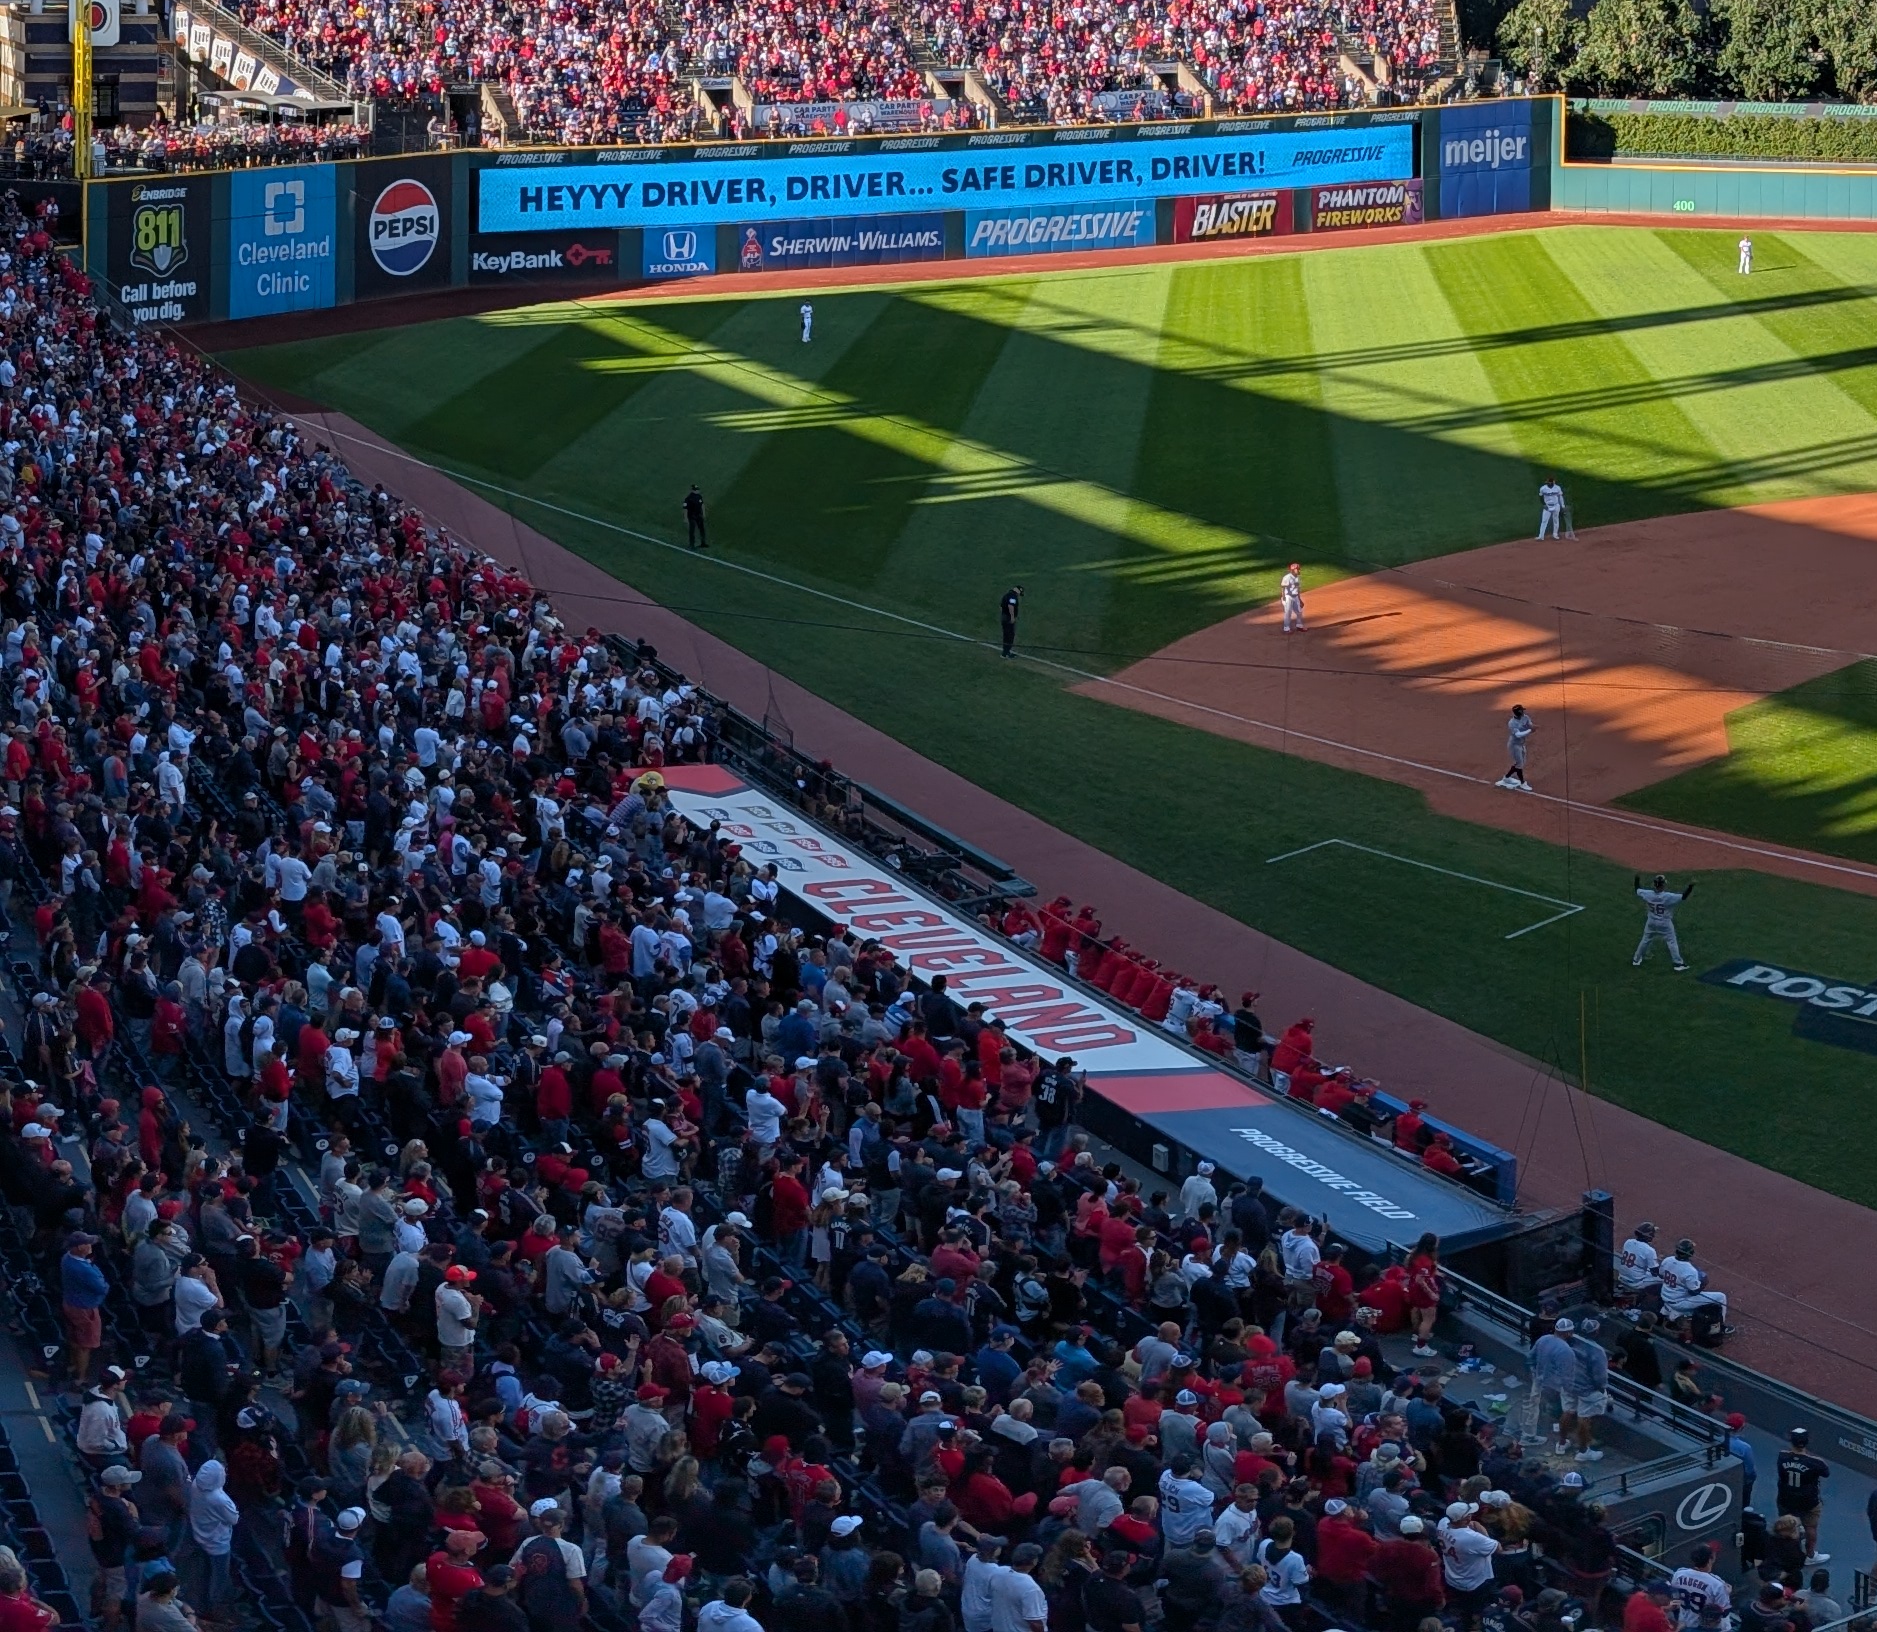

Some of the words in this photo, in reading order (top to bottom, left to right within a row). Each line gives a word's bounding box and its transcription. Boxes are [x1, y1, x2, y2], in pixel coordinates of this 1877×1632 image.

[1217, 120, 1271, 132] PROGRESSIVE
[1294, 116, 1347, 127] PROGRESSIVE
[1370, 111, 1420, 123] PROGRESSIVE
[1054, 129, 1110, 141] PROGRESSIVE
[1137, 125, 1192, 136] PROGRESSIVE
[1445, 129, 1526, 168] meijer
[519, 183, 634, 212] HEYYY
[642, 178, 777, 208] DRIVER,
[786, 171, 934, 201] DRIVER...
[941, 166, 1016, 194] SAFE
[1024, 159, 1143, 188] DRIVER,
[1151, 150, 1265, 180] DRIVER!
[1292, 145, 1385, 166] PROGRESSIVE
[1318, 185, 1404, 209] PHANTOM
[374, 215, 435, 240] PEPSI
[1191, 199, 1276, 238] BLASTER
[1317, 205, 1404, 228] FIREWORKS
[137, 209, 180, 251] 811
[971, 211, 1143, 247] PROGRESSIVE
[238, 236, 330, 266] Cleveland
[473, 249, 564, 273] KeyBank
[649, 261, 709, 273] HONDA
[121, 285, 147, 304] Call
[152, 281, 196, 300] before
[257, 271, 310, 296] Clinic
[132, 306, 157, 325] you
[160, 302, 185, 319] dig.
[803, 879, 1138, 1054] CLEVELAND
[1231, 1127, 1353, 1199] PROGRESSIVE
[1348, 1188, 1416, 1221] FIELD
[1788, 1471, 1801, 1487] 11
